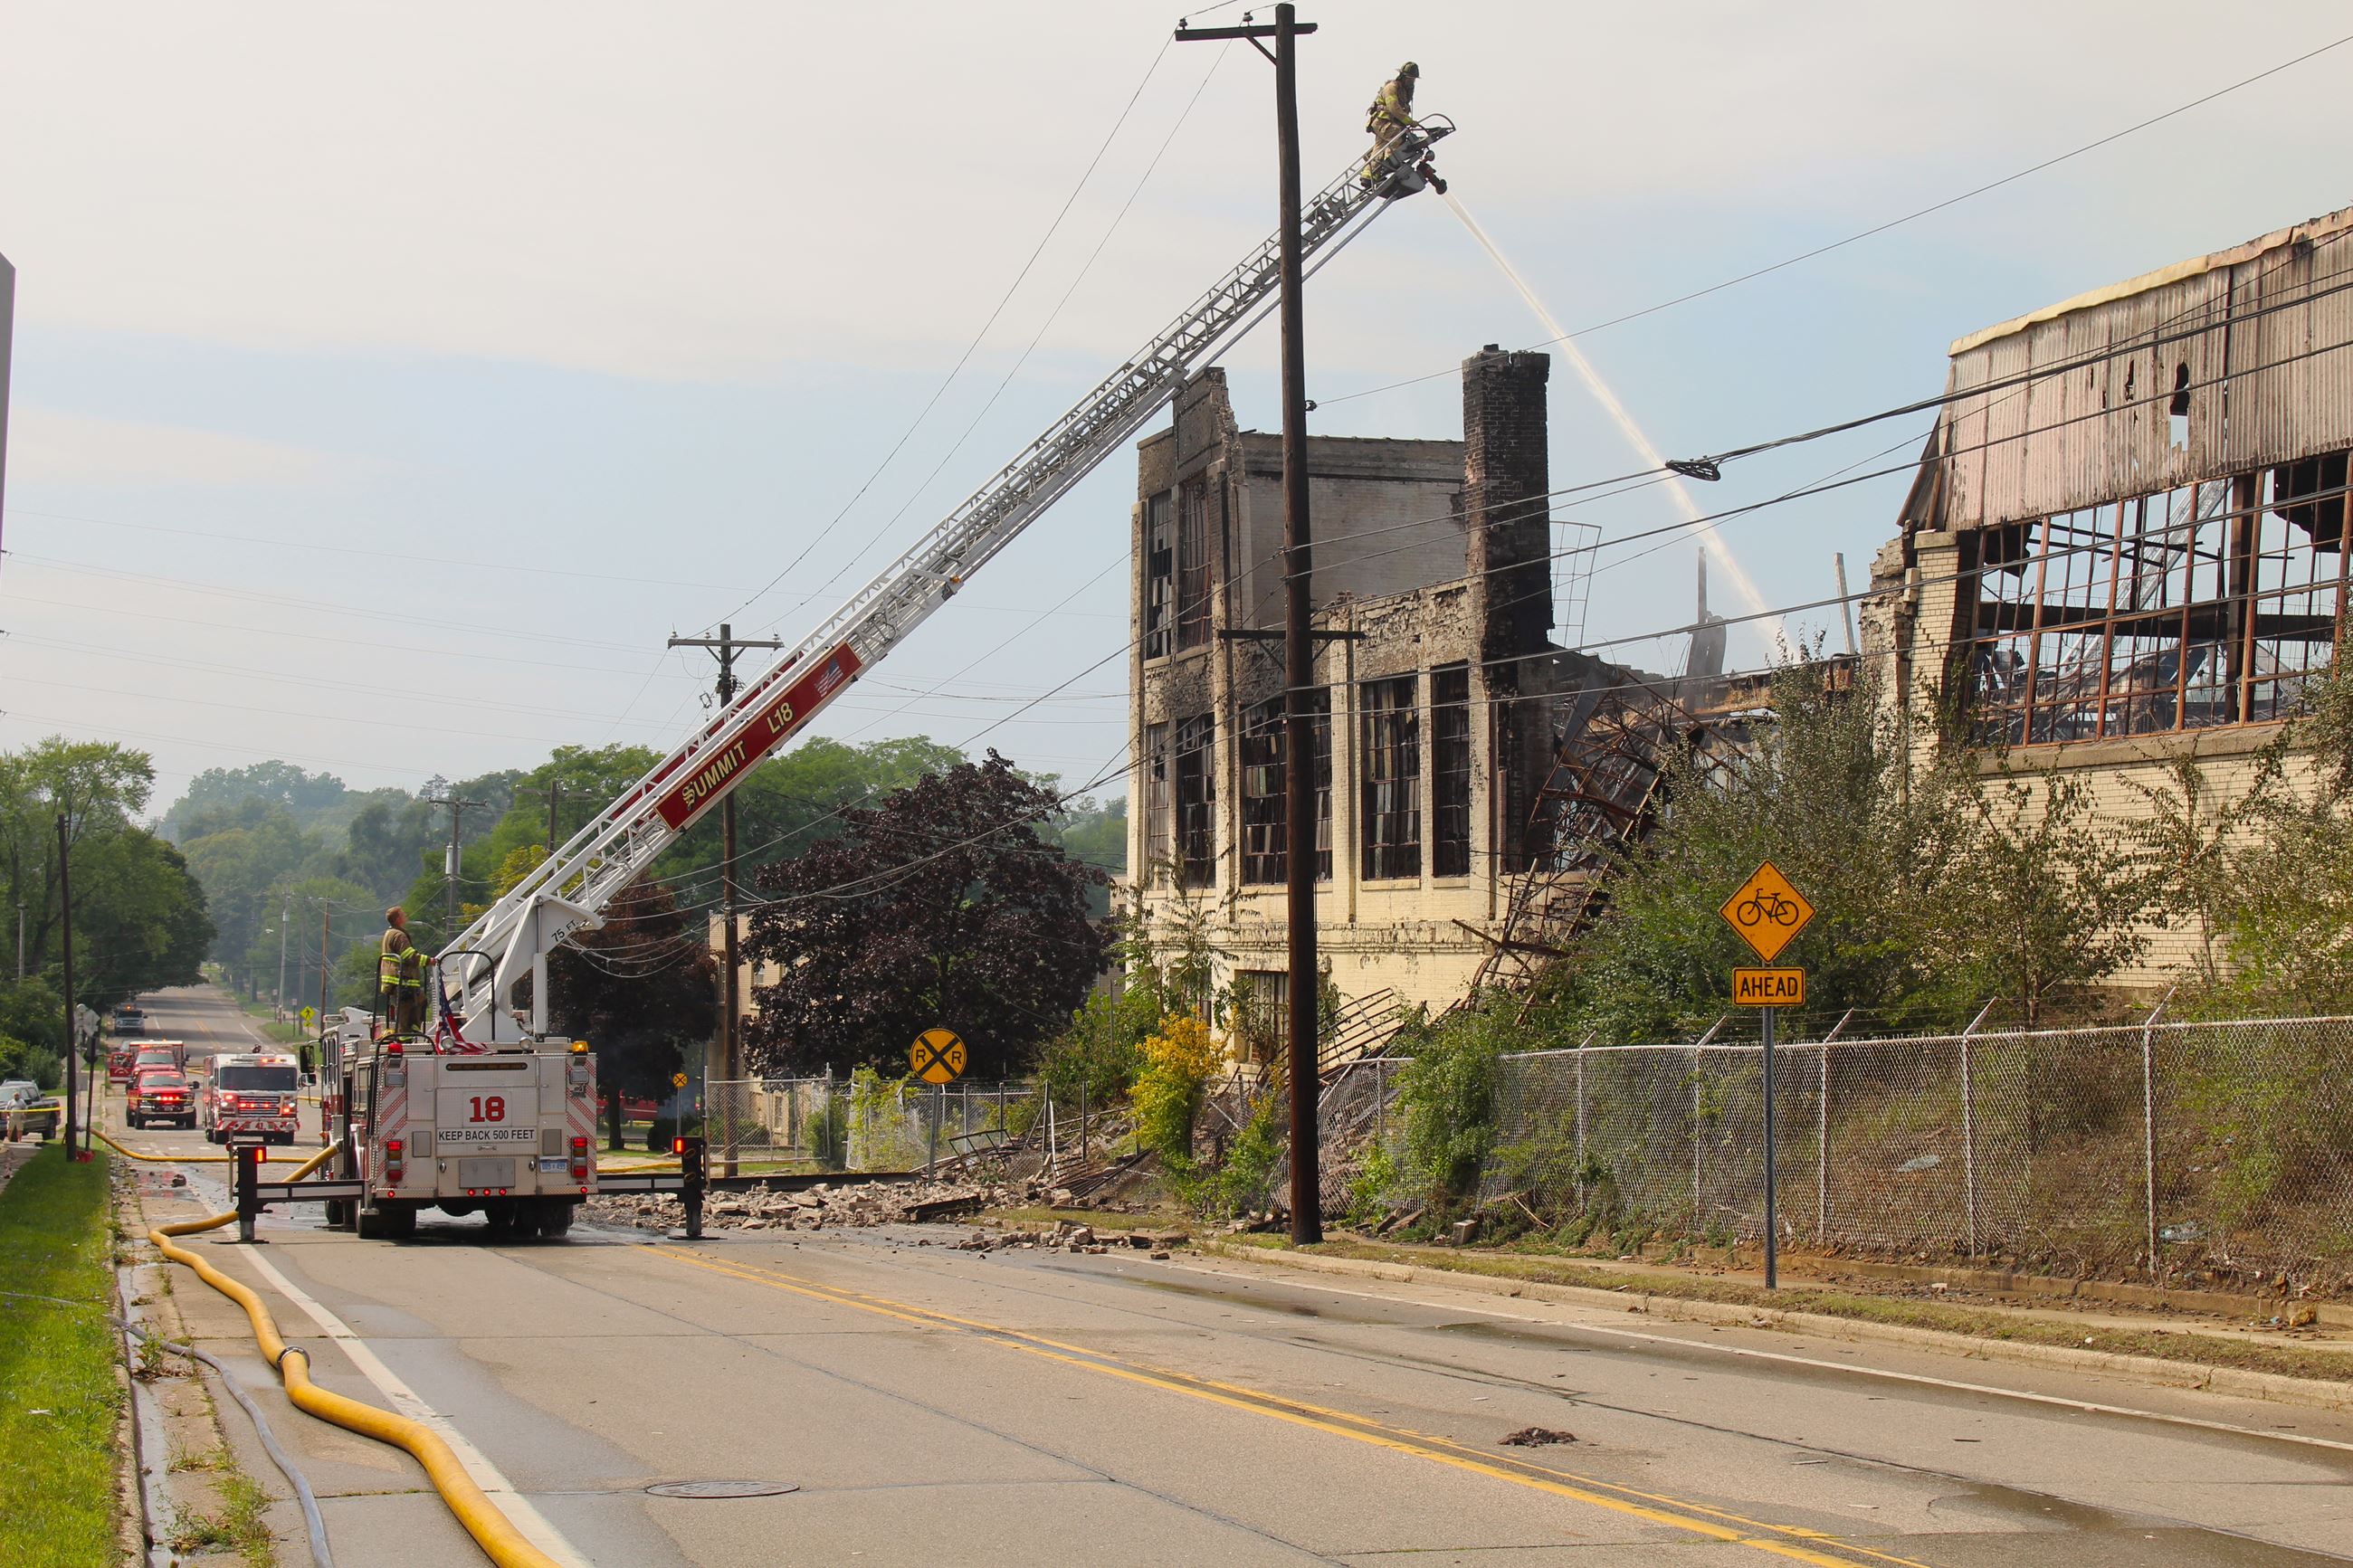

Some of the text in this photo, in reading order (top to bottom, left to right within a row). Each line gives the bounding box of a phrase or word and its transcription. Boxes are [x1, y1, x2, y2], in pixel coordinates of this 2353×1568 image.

[682, 702, 793, 811] SUMMIT L18
[551, 928, 566, 942] 75
[1740, 977, 1798, 997] AHEAD
[916, 1049, 962, 1064] R R
[470, 1096, 505, 1122] 18
[439, 1129, 535, 1141] KEEP BACK 500 FEET
